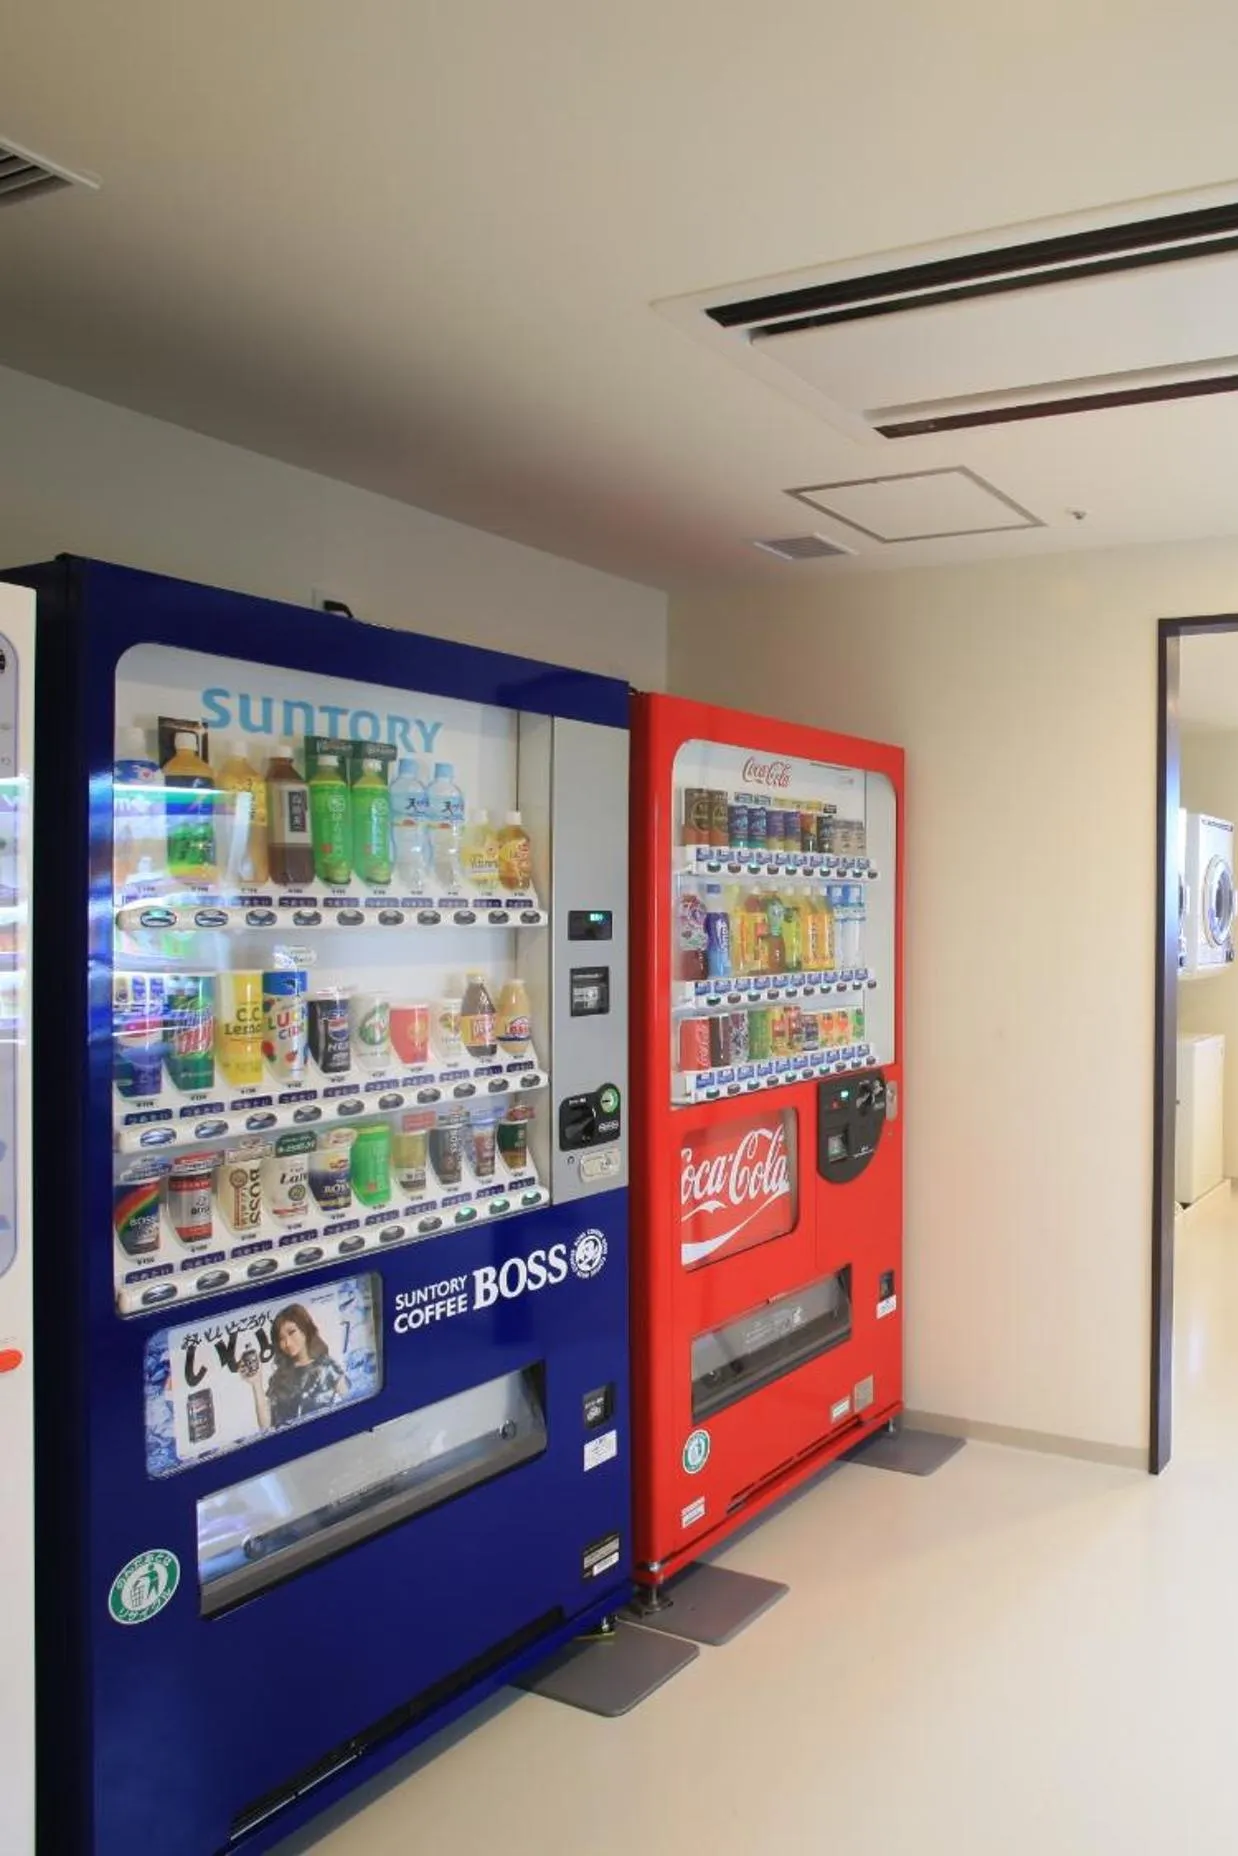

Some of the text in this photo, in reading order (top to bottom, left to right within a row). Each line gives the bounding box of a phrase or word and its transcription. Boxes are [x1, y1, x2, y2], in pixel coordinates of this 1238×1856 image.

[201, 686, 443, 754] SUNTORY
[395, 1275, 467, 1311] SUNTORY
[472, 1243, 569, 1311] BOSS
[393, 1294, 468, 1334] COFFEE
